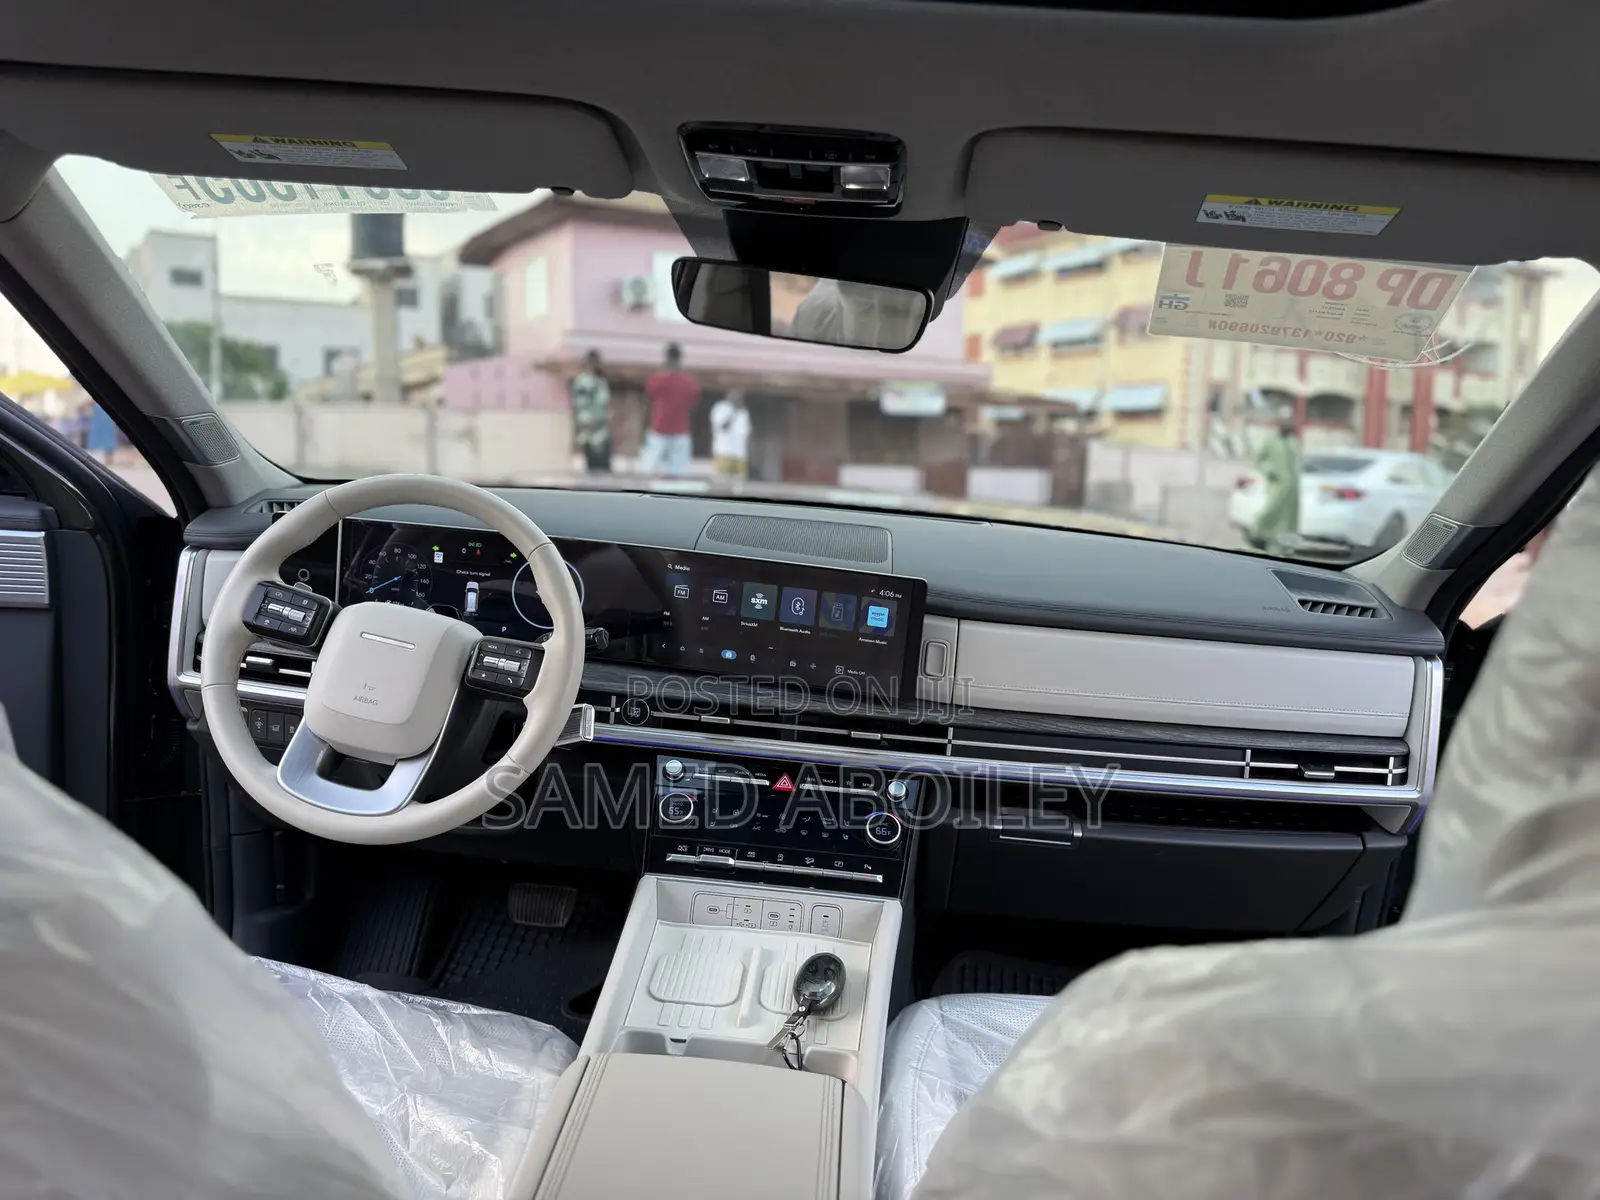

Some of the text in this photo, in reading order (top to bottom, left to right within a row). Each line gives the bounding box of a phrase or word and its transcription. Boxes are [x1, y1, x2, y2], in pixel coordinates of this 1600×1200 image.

[269, 137, 357, 148] WARNING
[1268, 199, 1359, 212] WARNING
[879, 589, 895, 598] 4:06
[751, 597, 768, 605] sxm
[352, 695, 379, 706] AIRBAG
